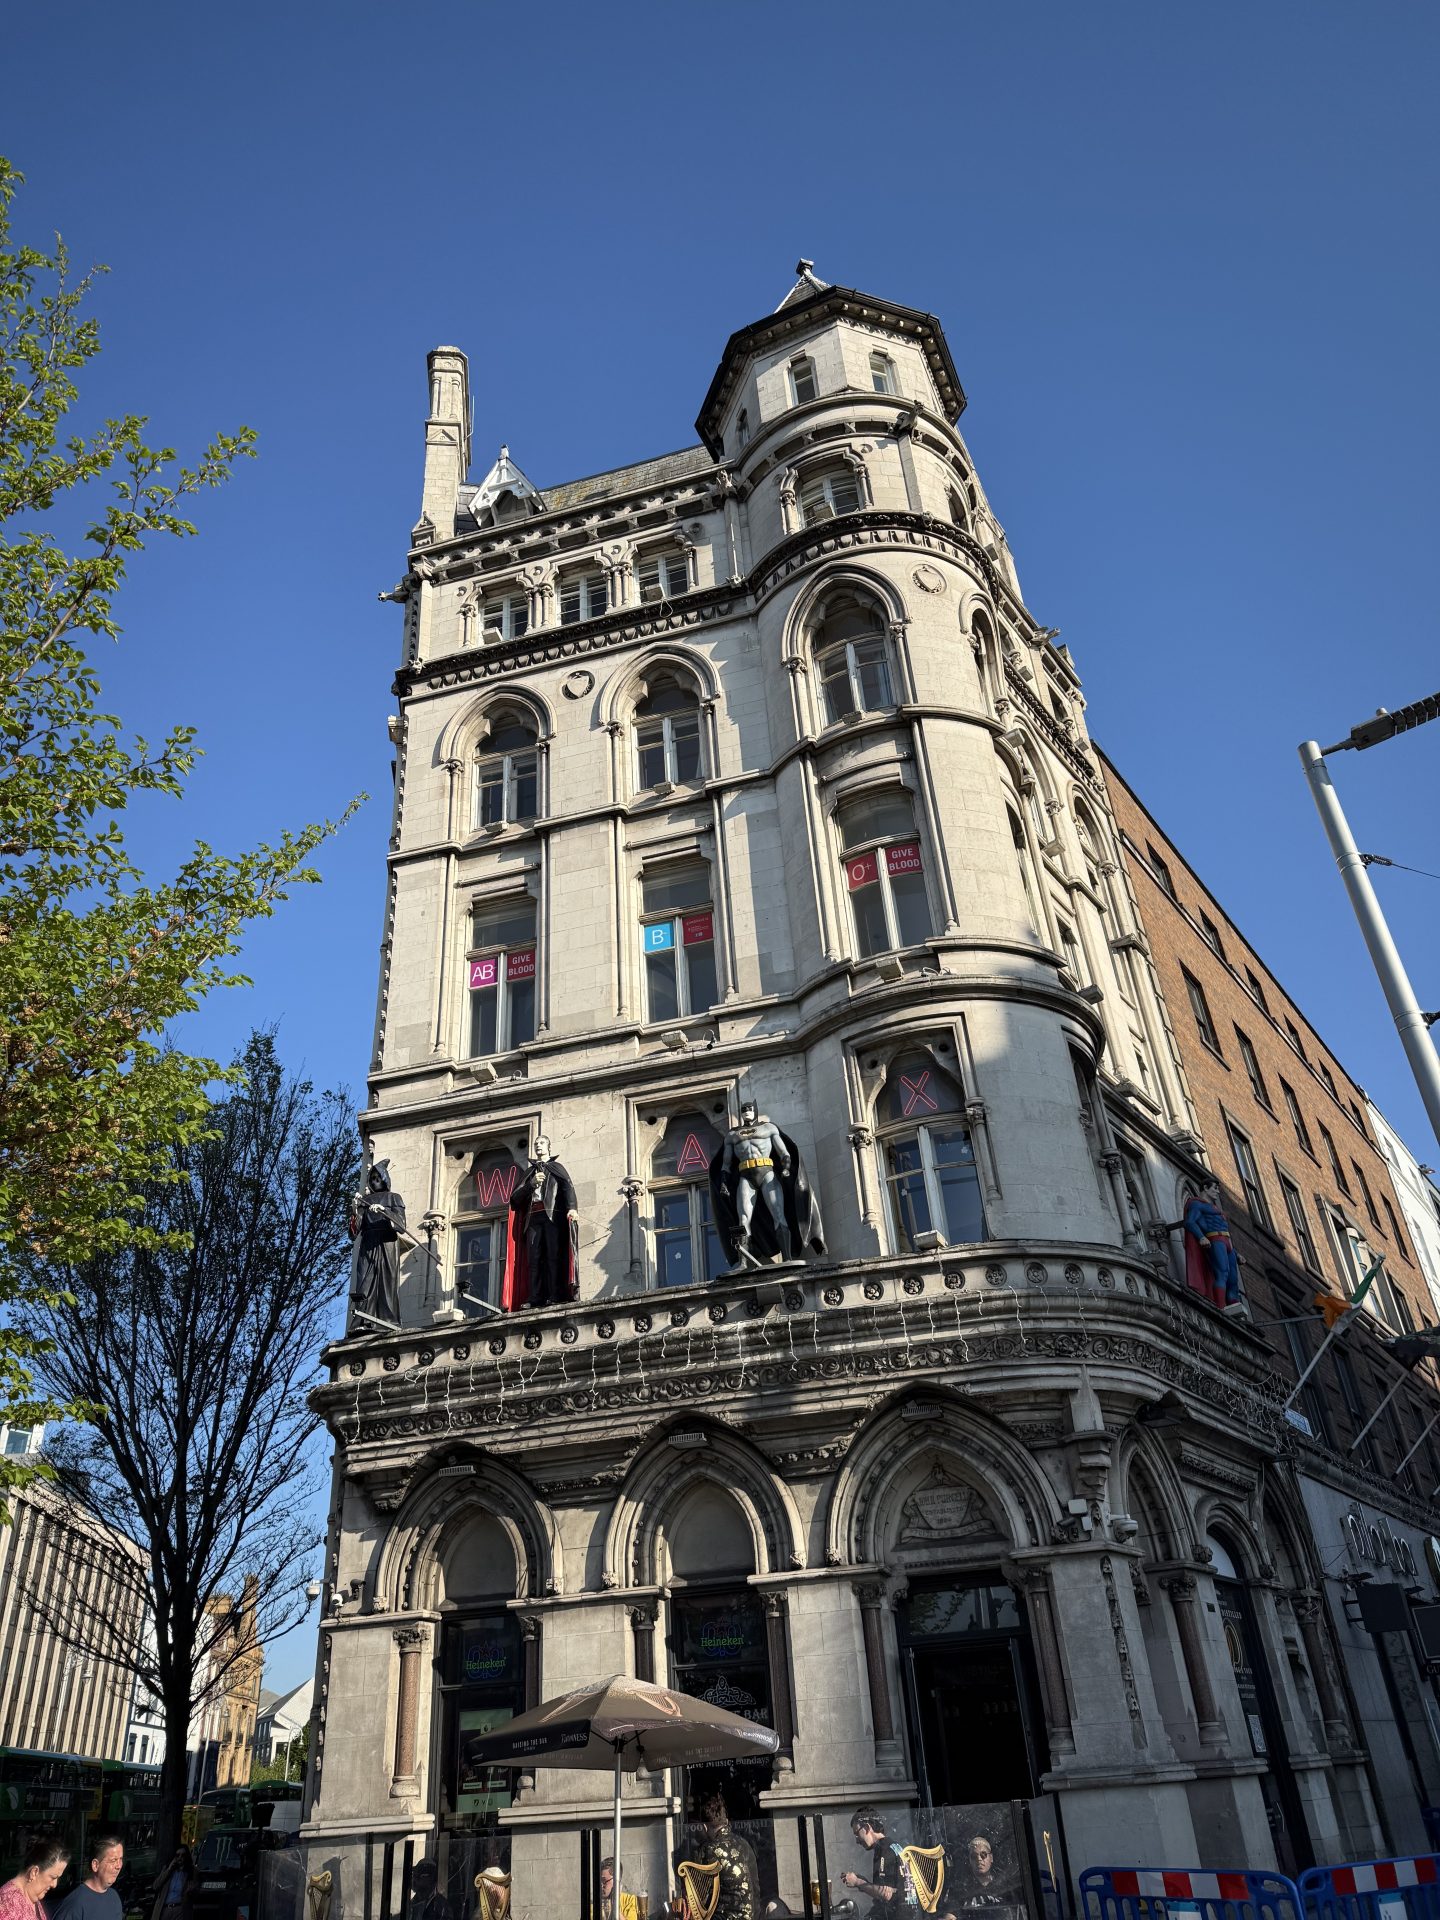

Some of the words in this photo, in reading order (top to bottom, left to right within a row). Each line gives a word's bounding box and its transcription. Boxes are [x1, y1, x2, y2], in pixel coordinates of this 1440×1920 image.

[891, 848, 914, 859] GIVE
[889, 858, 920, 871] BLOOD
[512, 954, 531, 965] GIVE
[508, 964, 535, 976] BLOOD
[477, 1165, 517, 1208] W
[677, 1133, 709, 1173] A
[900, 1070, 938, 1116] X
[700, 1636, 744, 1647] Heineken
[465, 1659, 506, 1670] Heineken
[744, 1707, 768, 1720] BAR
